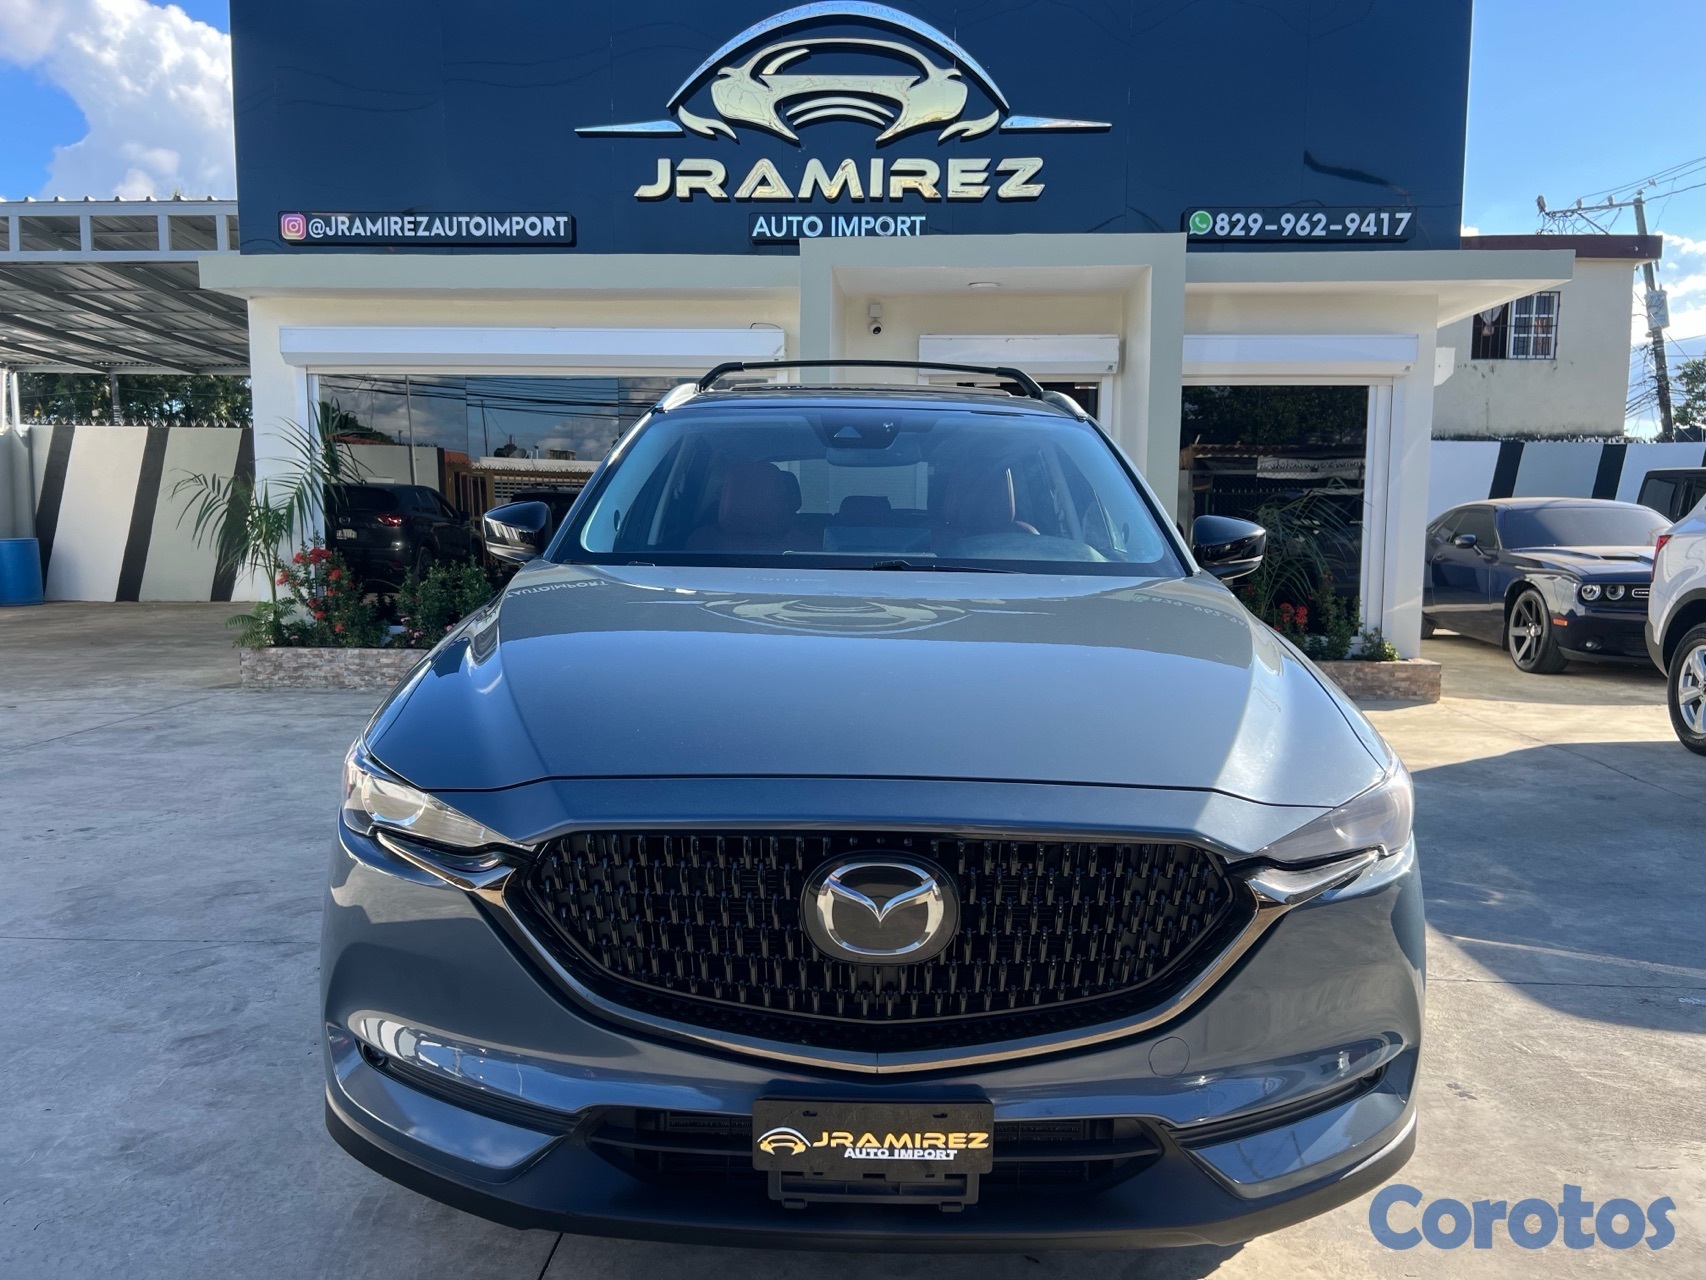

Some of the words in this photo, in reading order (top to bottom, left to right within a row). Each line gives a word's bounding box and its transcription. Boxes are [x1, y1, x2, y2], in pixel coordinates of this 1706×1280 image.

[633, 157, 1046, 199] JRAMIREZ
[308, 215, 568, 237] @JRAMIREZAUTOIMPORT
[752, 215, 824, 237] AUTO
[831, 215, 927, 237] IMPORT
[1214, 212, 1412, 236] 829-962-9417
[813, 1131, 989, 1149] JRAMIREZ
[844, 1147, 889, 1159] AUTO
[894, 1148, 958, 1160] IMPORT
